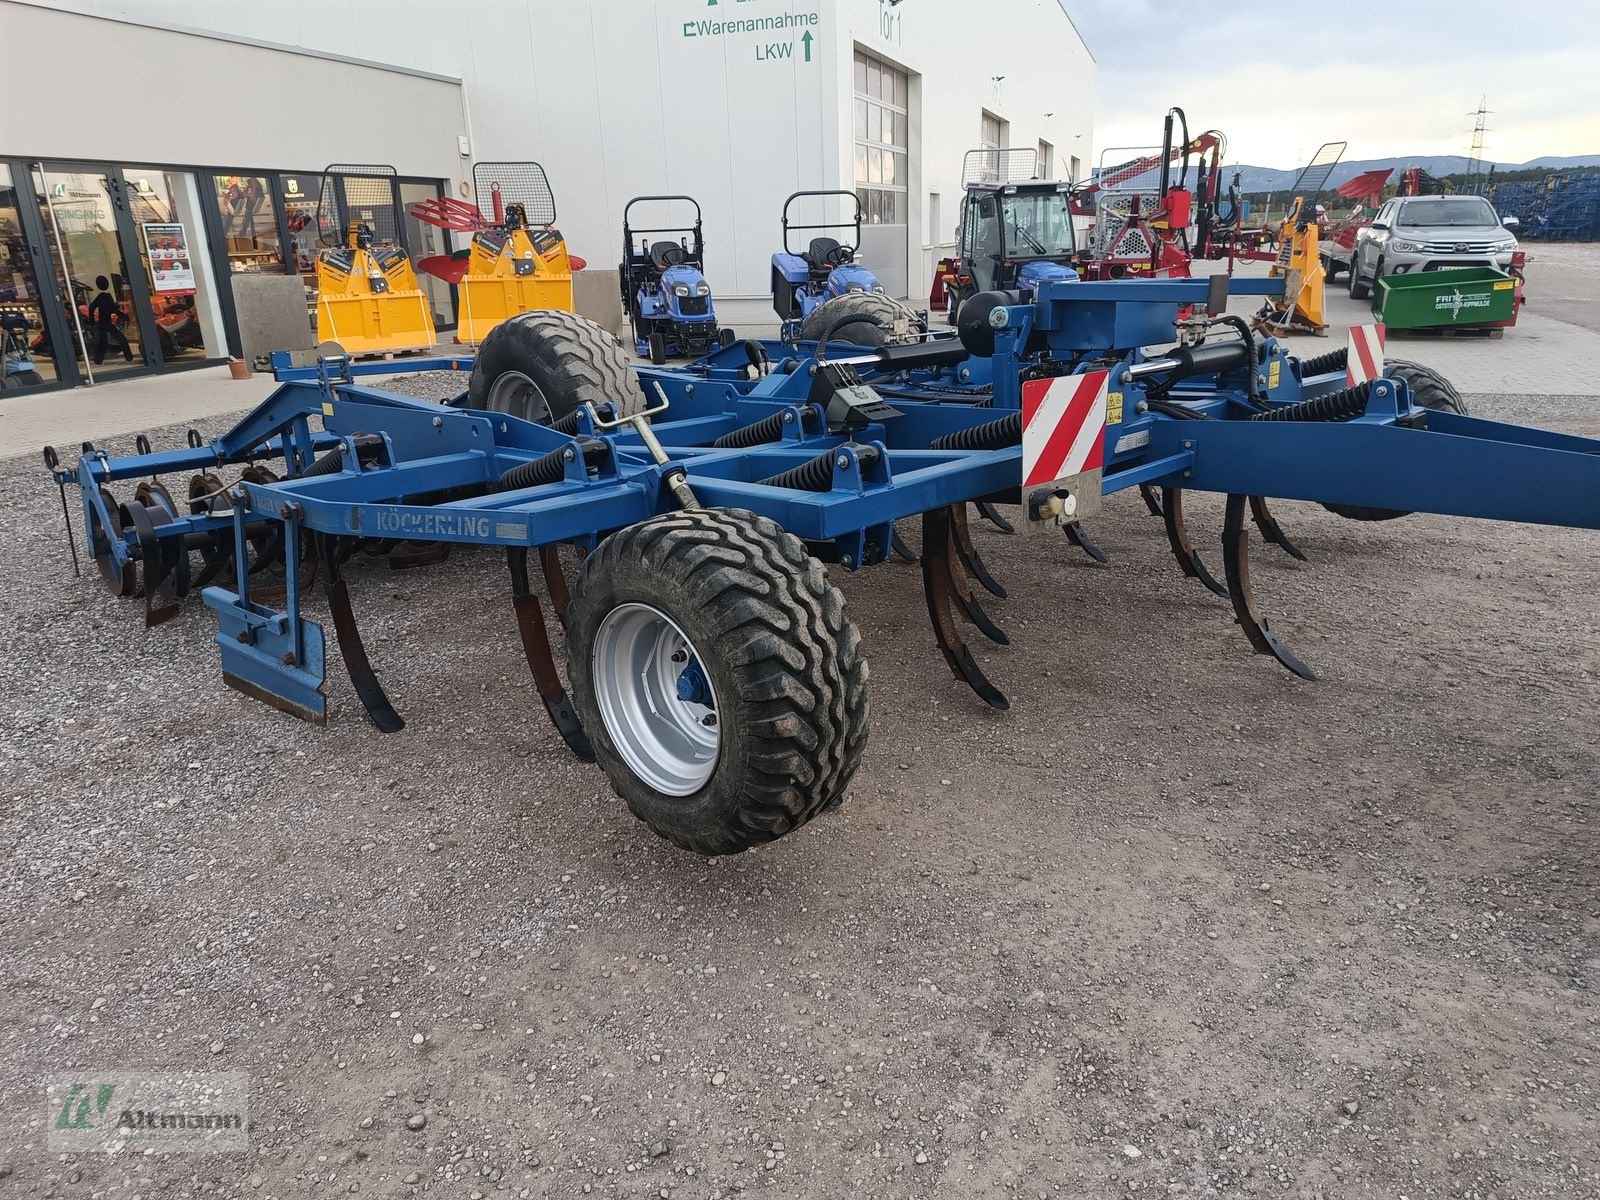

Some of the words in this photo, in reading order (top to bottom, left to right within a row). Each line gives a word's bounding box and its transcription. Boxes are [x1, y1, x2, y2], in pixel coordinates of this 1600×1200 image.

[696, 12, 818, 36] Warenannahme
[756, 42, 793, 60] LKW
[57, 209, 105, 219] EINGANG
[377, 508, 489, 537] KÖCKERLING
